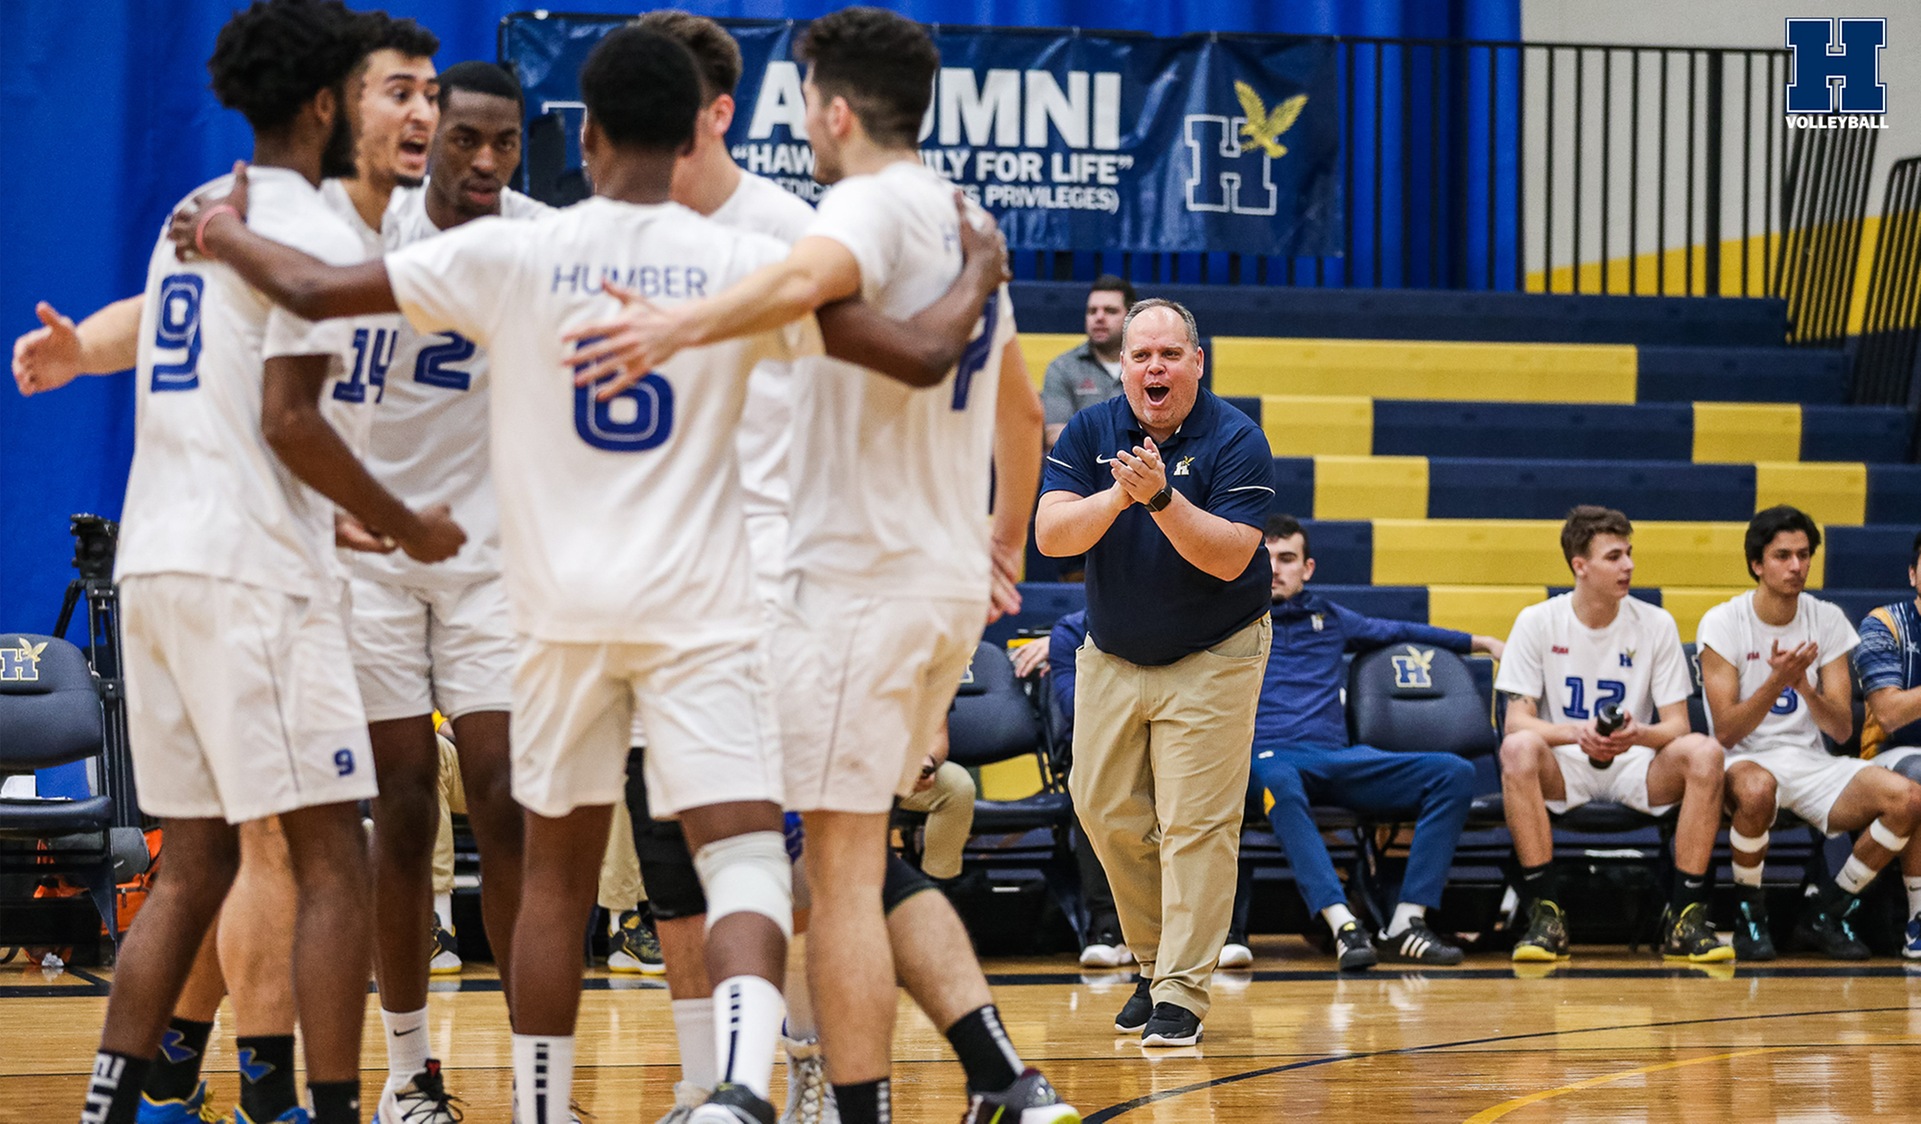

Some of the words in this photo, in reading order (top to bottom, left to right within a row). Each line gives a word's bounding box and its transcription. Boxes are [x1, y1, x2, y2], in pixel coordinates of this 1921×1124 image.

[975, 151, 1043, 182] FOR
[1051, 152, 1135, 185] LIFE”
[1184, 114, 1277, 215] H
[985, 184, 1120, 215] PRIVILEGES)
[151, 274, 204, 393] 9
[333, 328, 399, 404] 14
[414, 330, 476, 392] 2
[574, 334, 675, 452] 6
[0, 648, 39, 681] H
[1391, 655, 1432, 688] H
[1563, 677, 1626, 720] 12
[335, 748, 355, 776] 9
